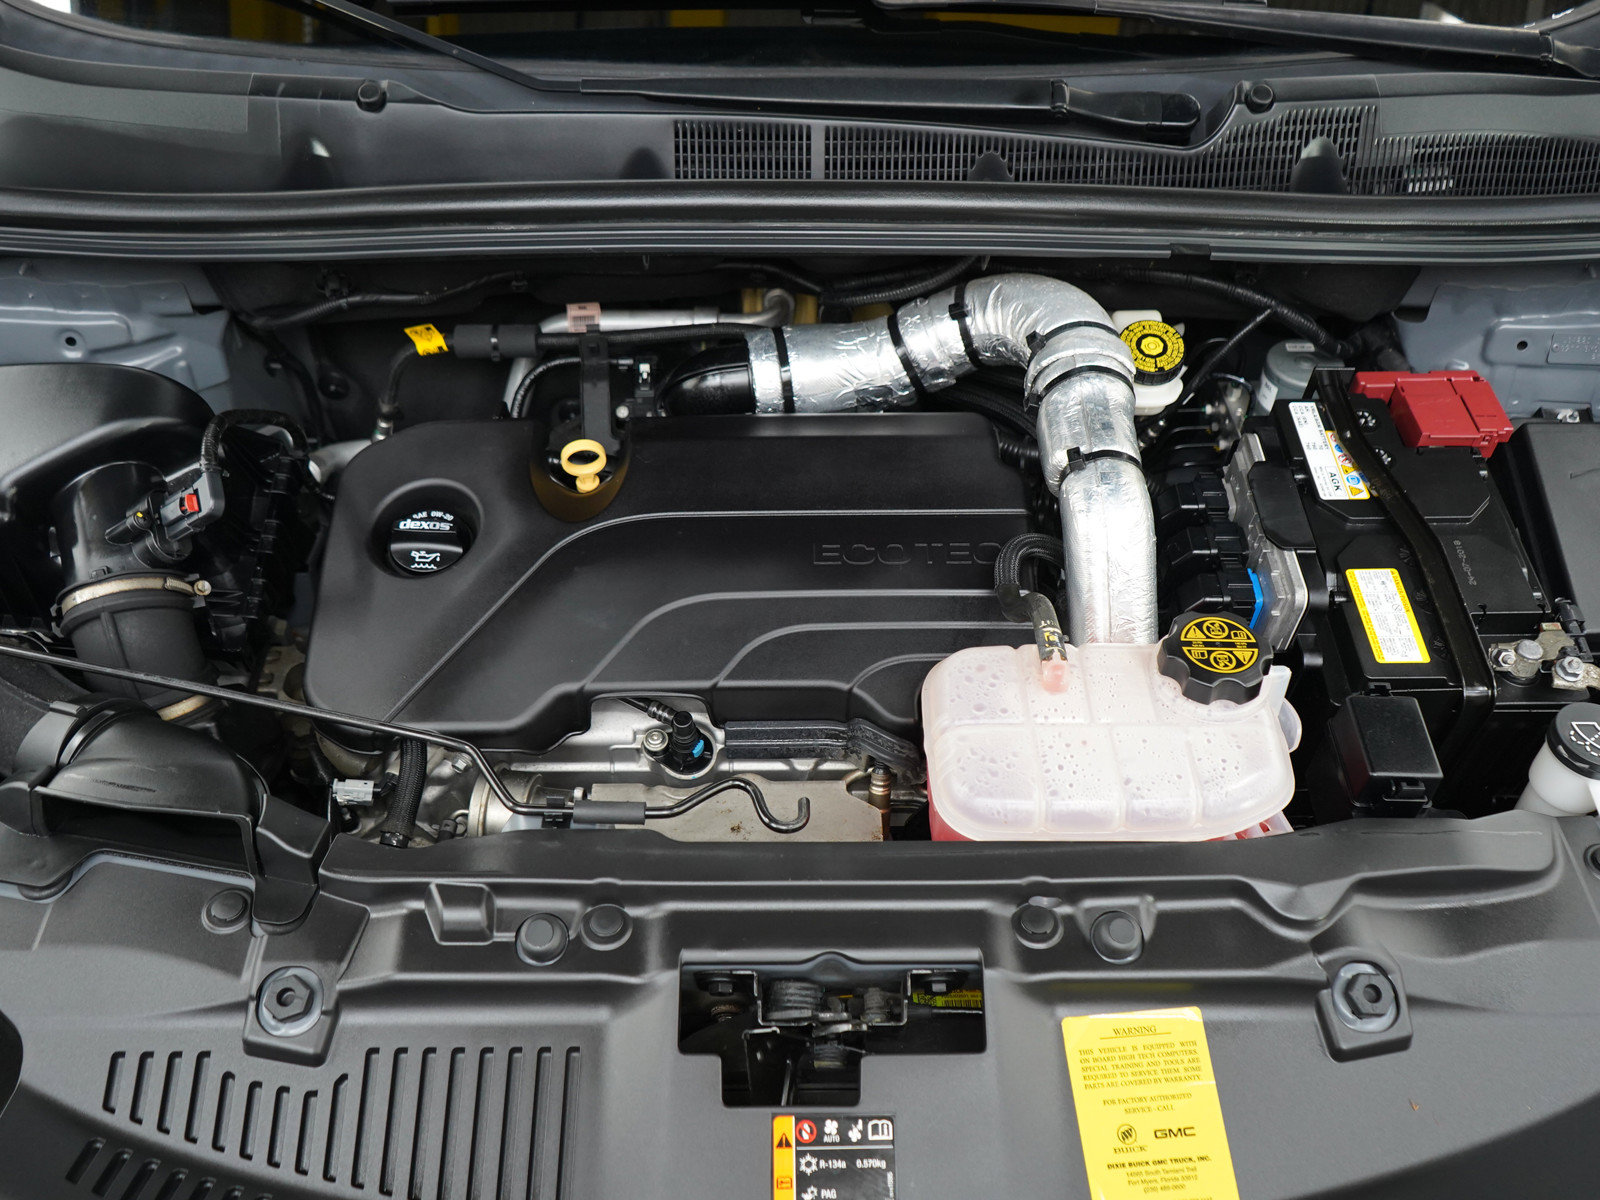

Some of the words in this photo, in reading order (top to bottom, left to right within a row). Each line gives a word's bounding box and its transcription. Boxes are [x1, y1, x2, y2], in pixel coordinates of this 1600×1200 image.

[1329, 472, 1341, 491] AGK
[412, 511, 428, 520] SAE
[430, 510, 454, 521] 0W-20
[399, 518, 453, 531] dexos
[813, 542, 1001, 565] ECOTEC
[1112, 1025, 1157, 1036] WARNING
[1099, 1046, 1127, 1055] VEHICLE
[1143, 1042, 1175, 1052] EQUIPPED
[1179, 1040, 1198, 1048] WITH
[1081, 1065, 1108, 1073] SPECIAL
[1111, 1062, 1143, 1070] TRAINING
[1163, 1058, 1184, 1066] TOOLS
[1187, 1056, 1200, 1064] ARE
[1092, 1055, 1116, 1063] BOARD
[1083, 1073, 1117, 1081] REQUIRED
[1131, 1069, 1158, 1077] SERVICE
[1183, 1065, 1201, 1073] SOME
[1084, 1082, 1105, 1090] PARTS
[1120, 1078, 1152, 1087] COVERED
[1118, 1096, 1147, 1105] FACTORY
[1150, 1092, 1193, 1102] AUTHORIZED
[1124, 1106, 1152, 1114] SERVICE
[1157, 1104, 1175, 1112] CALL
[823, 1134, 841, 1143] AUTO
[1154, 1126, 1196, 1140] GMC
[1113, 1145, 1148, 1155] BUICK
[819, 1159, 847, 1169] R-134a
[856, 1158, 887, 1170] 0.570kg
[1107, 1162, 1126, 1170] DIXIE
[1128, 1160, 1150, 1168] BUICK
[1153, 1158, 1168, 1166] GMC
[1170, 1156, 1196, 1164] TRUCK,
[1127, 1178, 1140, 1186] Fort
[821, 1189, 837, 1199] PAG
